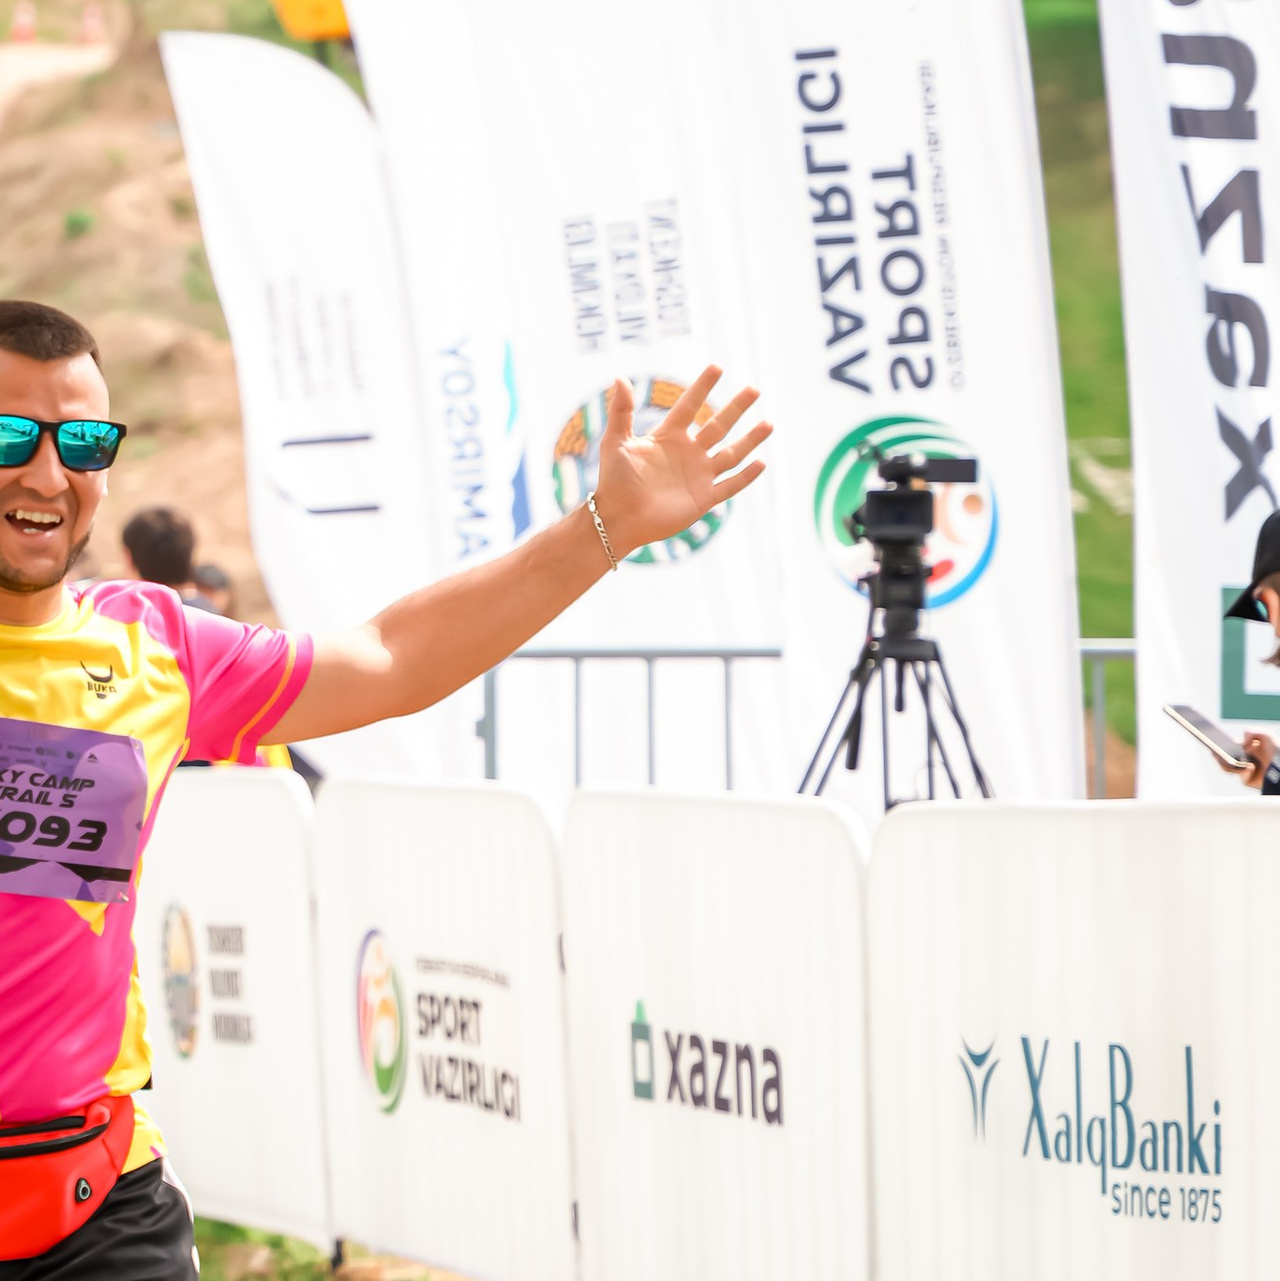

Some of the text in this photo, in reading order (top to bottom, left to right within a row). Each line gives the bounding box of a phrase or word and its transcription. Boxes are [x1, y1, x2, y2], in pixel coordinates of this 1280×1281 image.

[29, 773, 95, 792] CAMP
[417, 993, 482, 1045] SPORT
[418, 1053, 521, 1123] VAZIRLIGI
[664, 1030, 784, 1126] xazna
[1021, 1035, 1221, 1195] XalqBanki
[1112, 1182, 1222, 1223] since 1875
